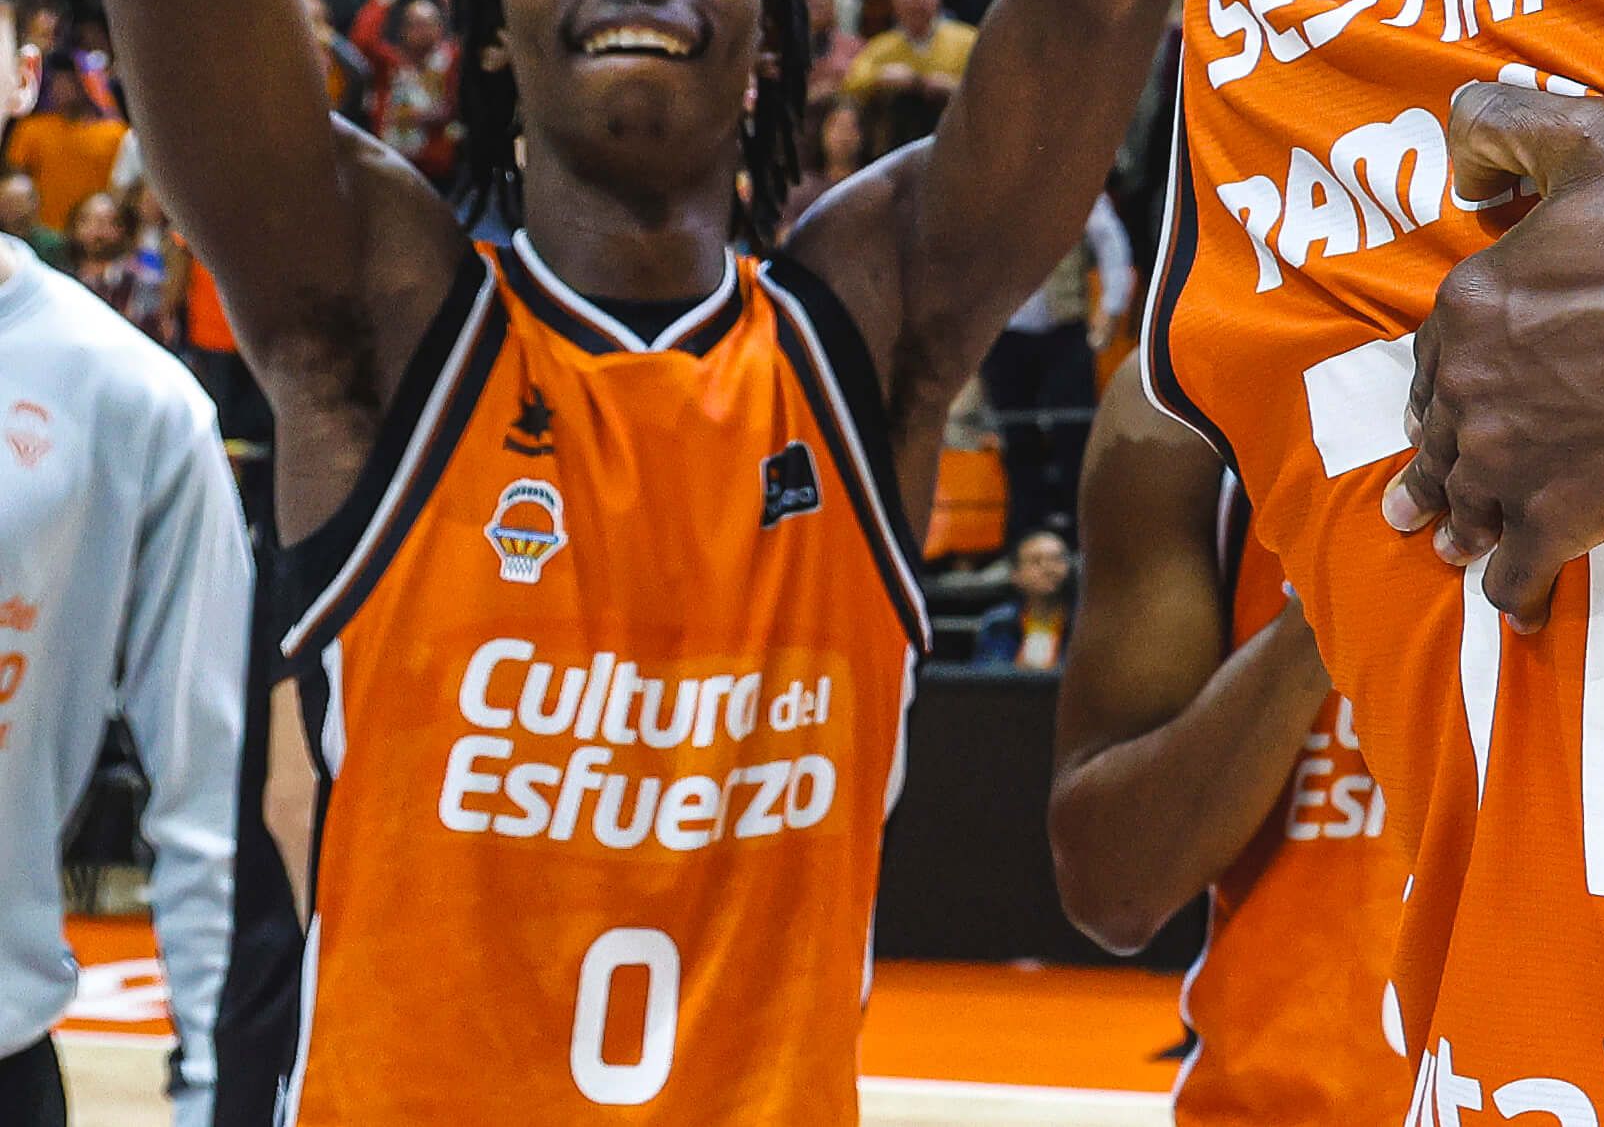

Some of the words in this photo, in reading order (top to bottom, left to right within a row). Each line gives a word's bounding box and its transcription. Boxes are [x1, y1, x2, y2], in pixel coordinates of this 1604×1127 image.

[458, 637, 762, 748] Cultura
[768, 675, 830, 732] del
[438, 735, 837, 851] Esfuerzo
[569, 927, 680, 1106] 0
